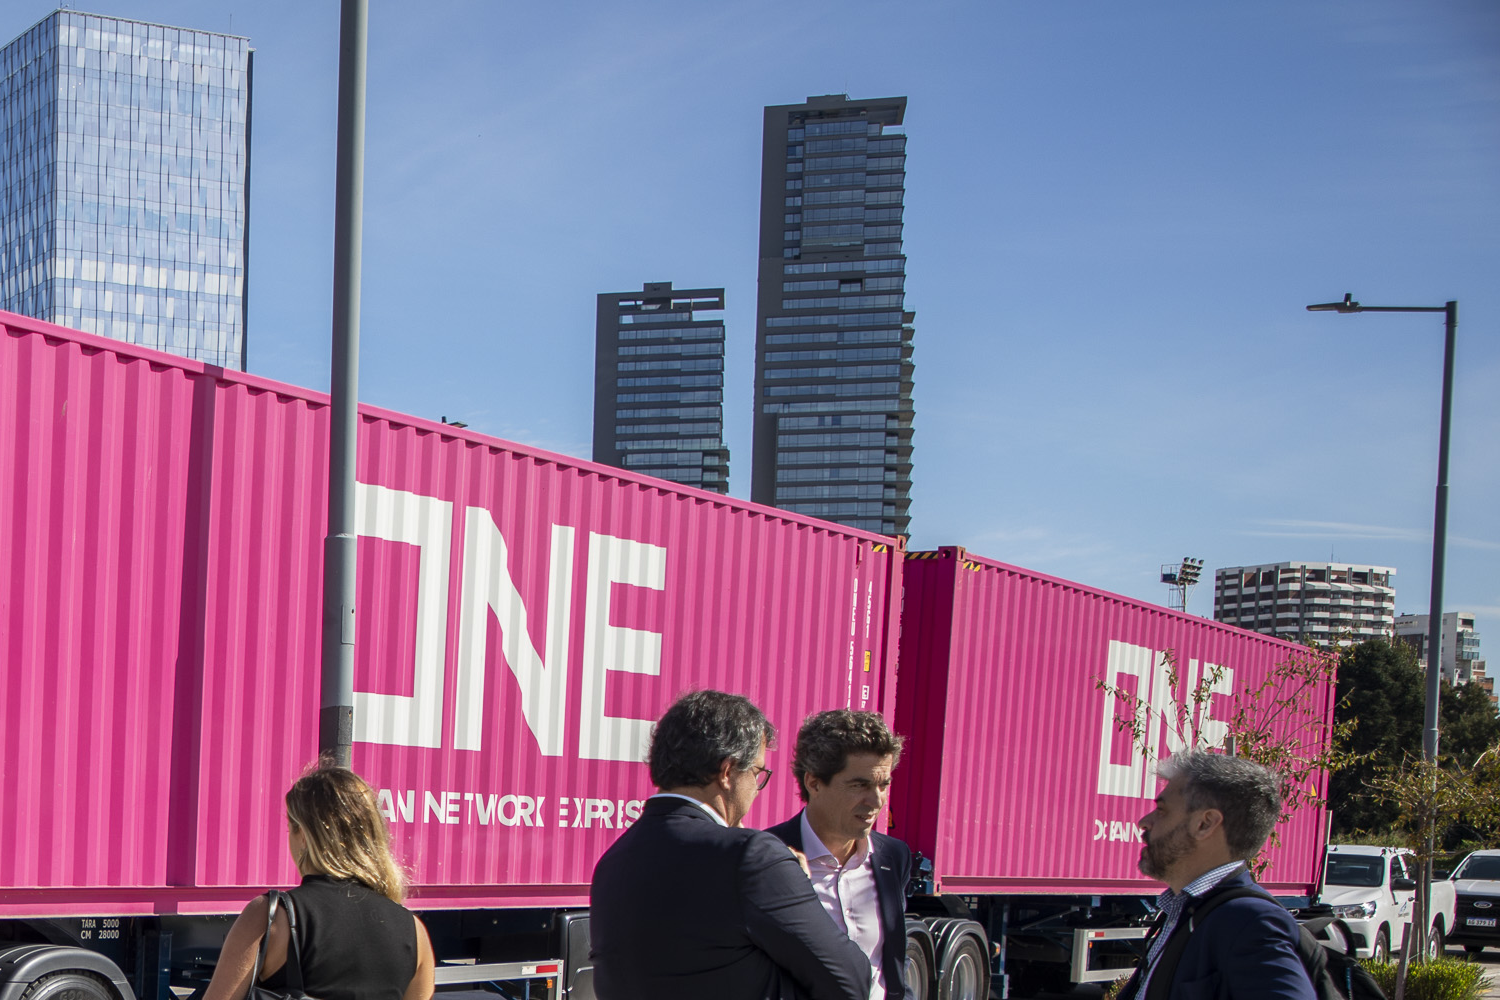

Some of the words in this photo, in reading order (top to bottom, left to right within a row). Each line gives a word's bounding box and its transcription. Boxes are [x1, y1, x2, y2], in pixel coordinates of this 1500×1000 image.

[351, 479, 668, 763] ONE
[424, 790, 546, 828] NETWORK
[558, 796, 646, 830] EXPRES
[80, 930, 92, 940] CM
[98, 930, 120, 939] 28000
[81, 919, 97, 928] TARA
[102, 919, 120, 928] 5000
